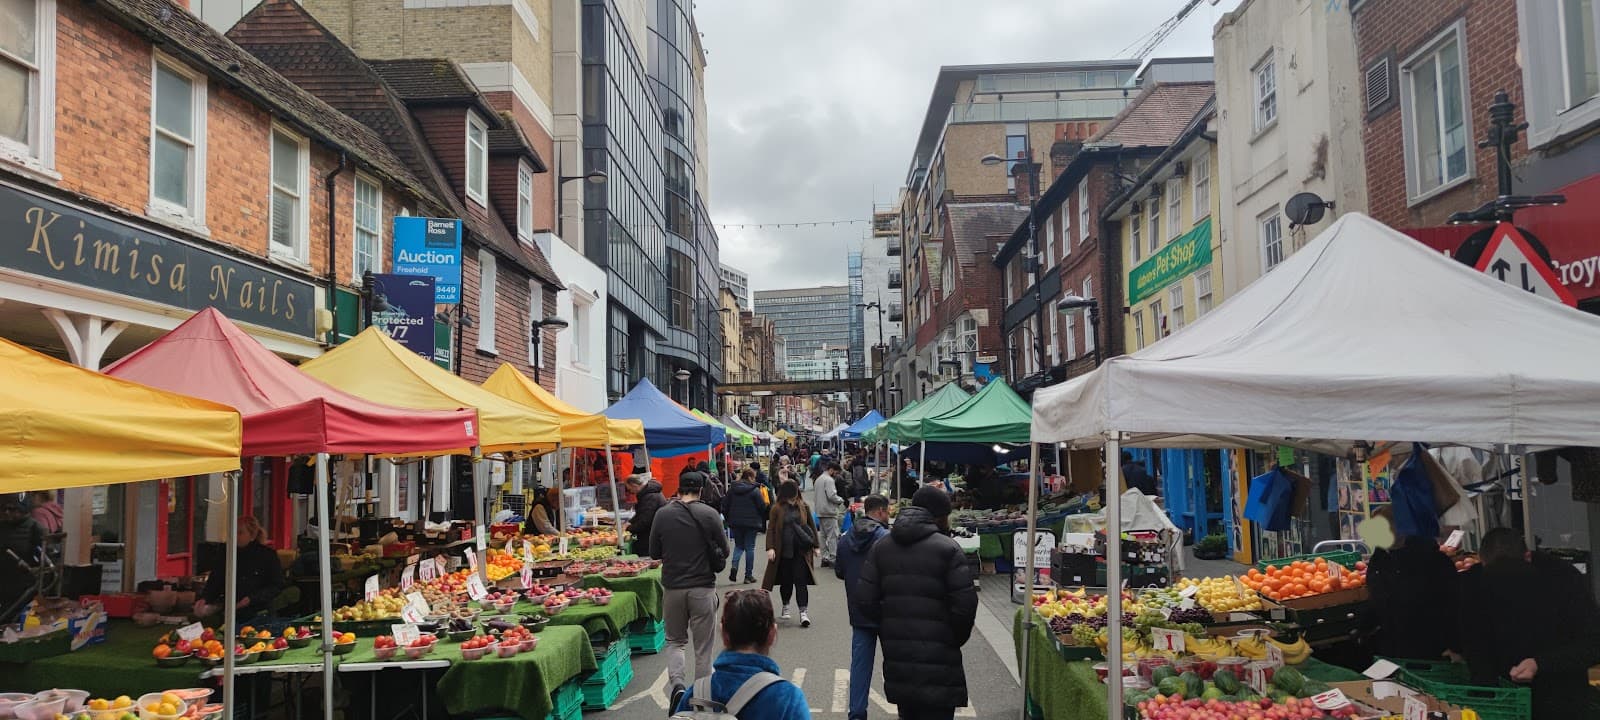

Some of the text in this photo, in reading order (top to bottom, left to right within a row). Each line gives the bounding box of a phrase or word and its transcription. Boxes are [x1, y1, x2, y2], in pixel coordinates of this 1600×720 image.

[427, 227, 446, 235] Ross
[397, 249, 455, 264] Auction
[1156, 240, 1196, 276] Pet Shop
[25, 206, 295, 320] Kimisa Nails
[397, 265, 428, 274] Freehold
[1551, 255, 1600, 288] roy
[436, 286, 456, 294] 9449
[371, 315, 424, 325] Protected
